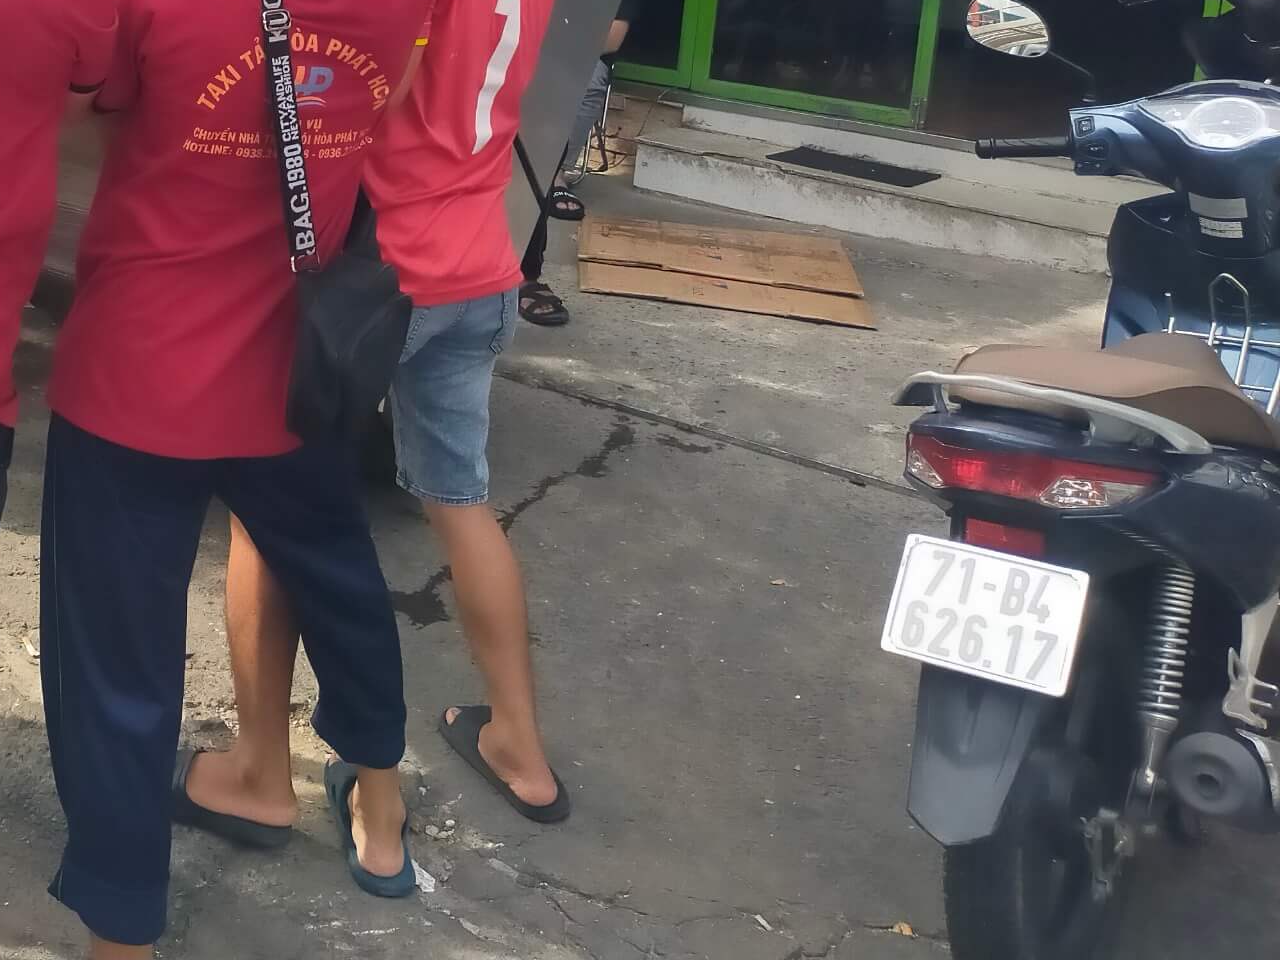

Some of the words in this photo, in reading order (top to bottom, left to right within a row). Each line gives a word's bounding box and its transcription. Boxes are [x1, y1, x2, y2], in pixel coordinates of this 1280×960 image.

[197, 64, 243, 110] TAXI
[239, 36, 266, 71] TẢ
[290, 27, 319, 53] ÒA
[325, 37, 379, 76] PHÁT
[183, 138, 233, 156] HOTLINE:
[193, 127, 236, 142] CHUYỂN
[924, 549, 1051, 624] 71-B4
[901, 600, 1059, 681] 626.17
